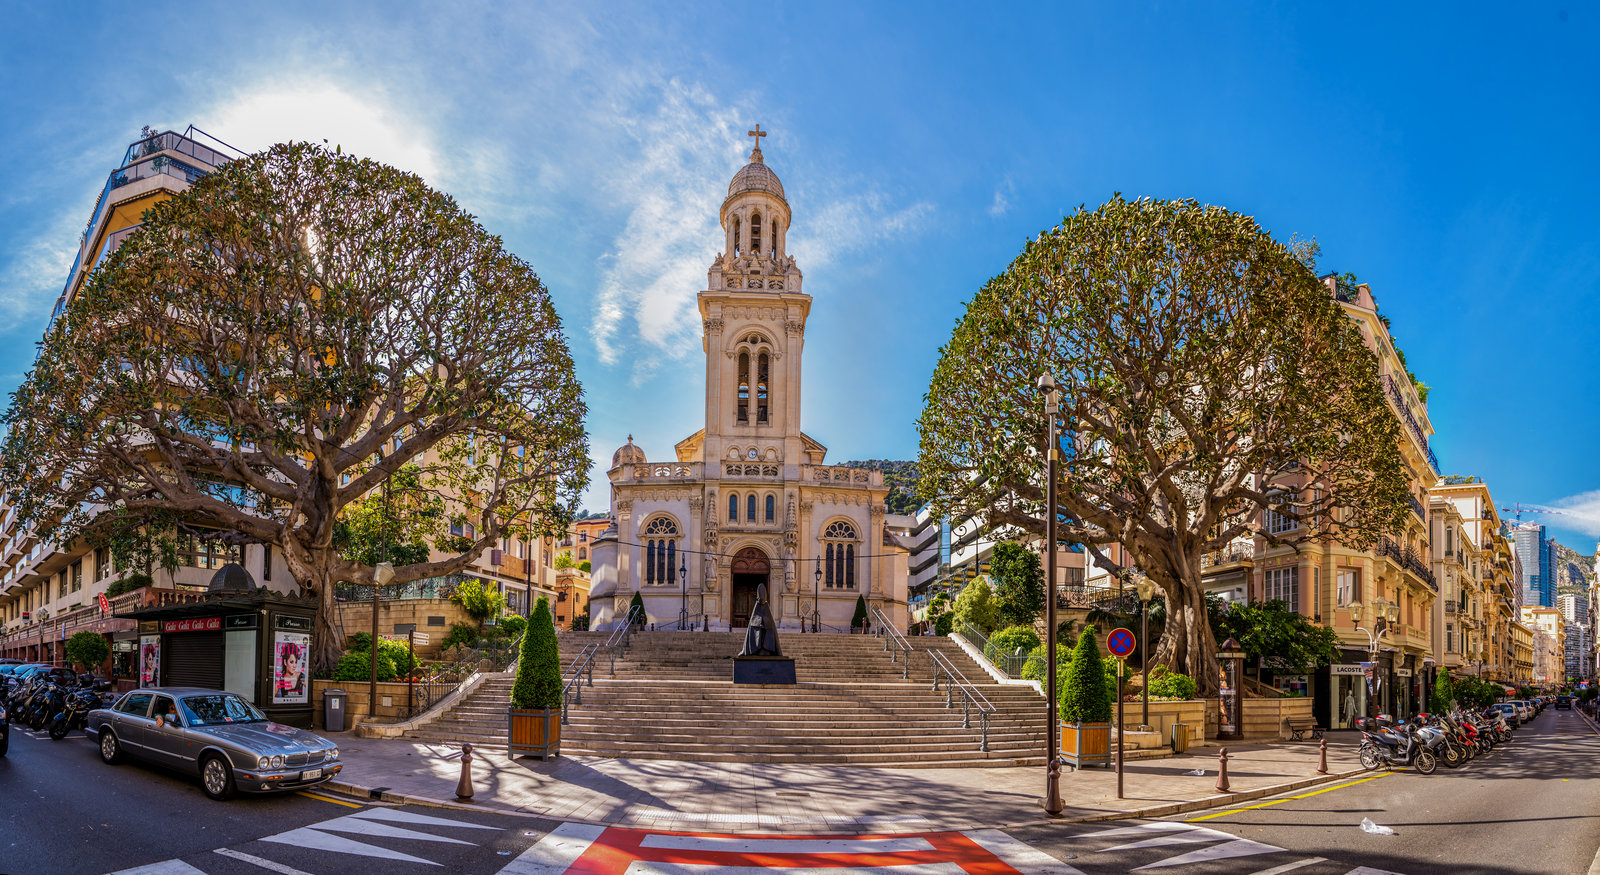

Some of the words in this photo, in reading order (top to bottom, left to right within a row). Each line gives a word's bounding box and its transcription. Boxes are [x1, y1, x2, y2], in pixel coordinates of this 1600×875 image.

[165, 622, 176, 631] Gala
[178, 621, 190, 630] Gala
[191, 620, 204, 629] Gala
[206, 619, 220, 629] Gala
